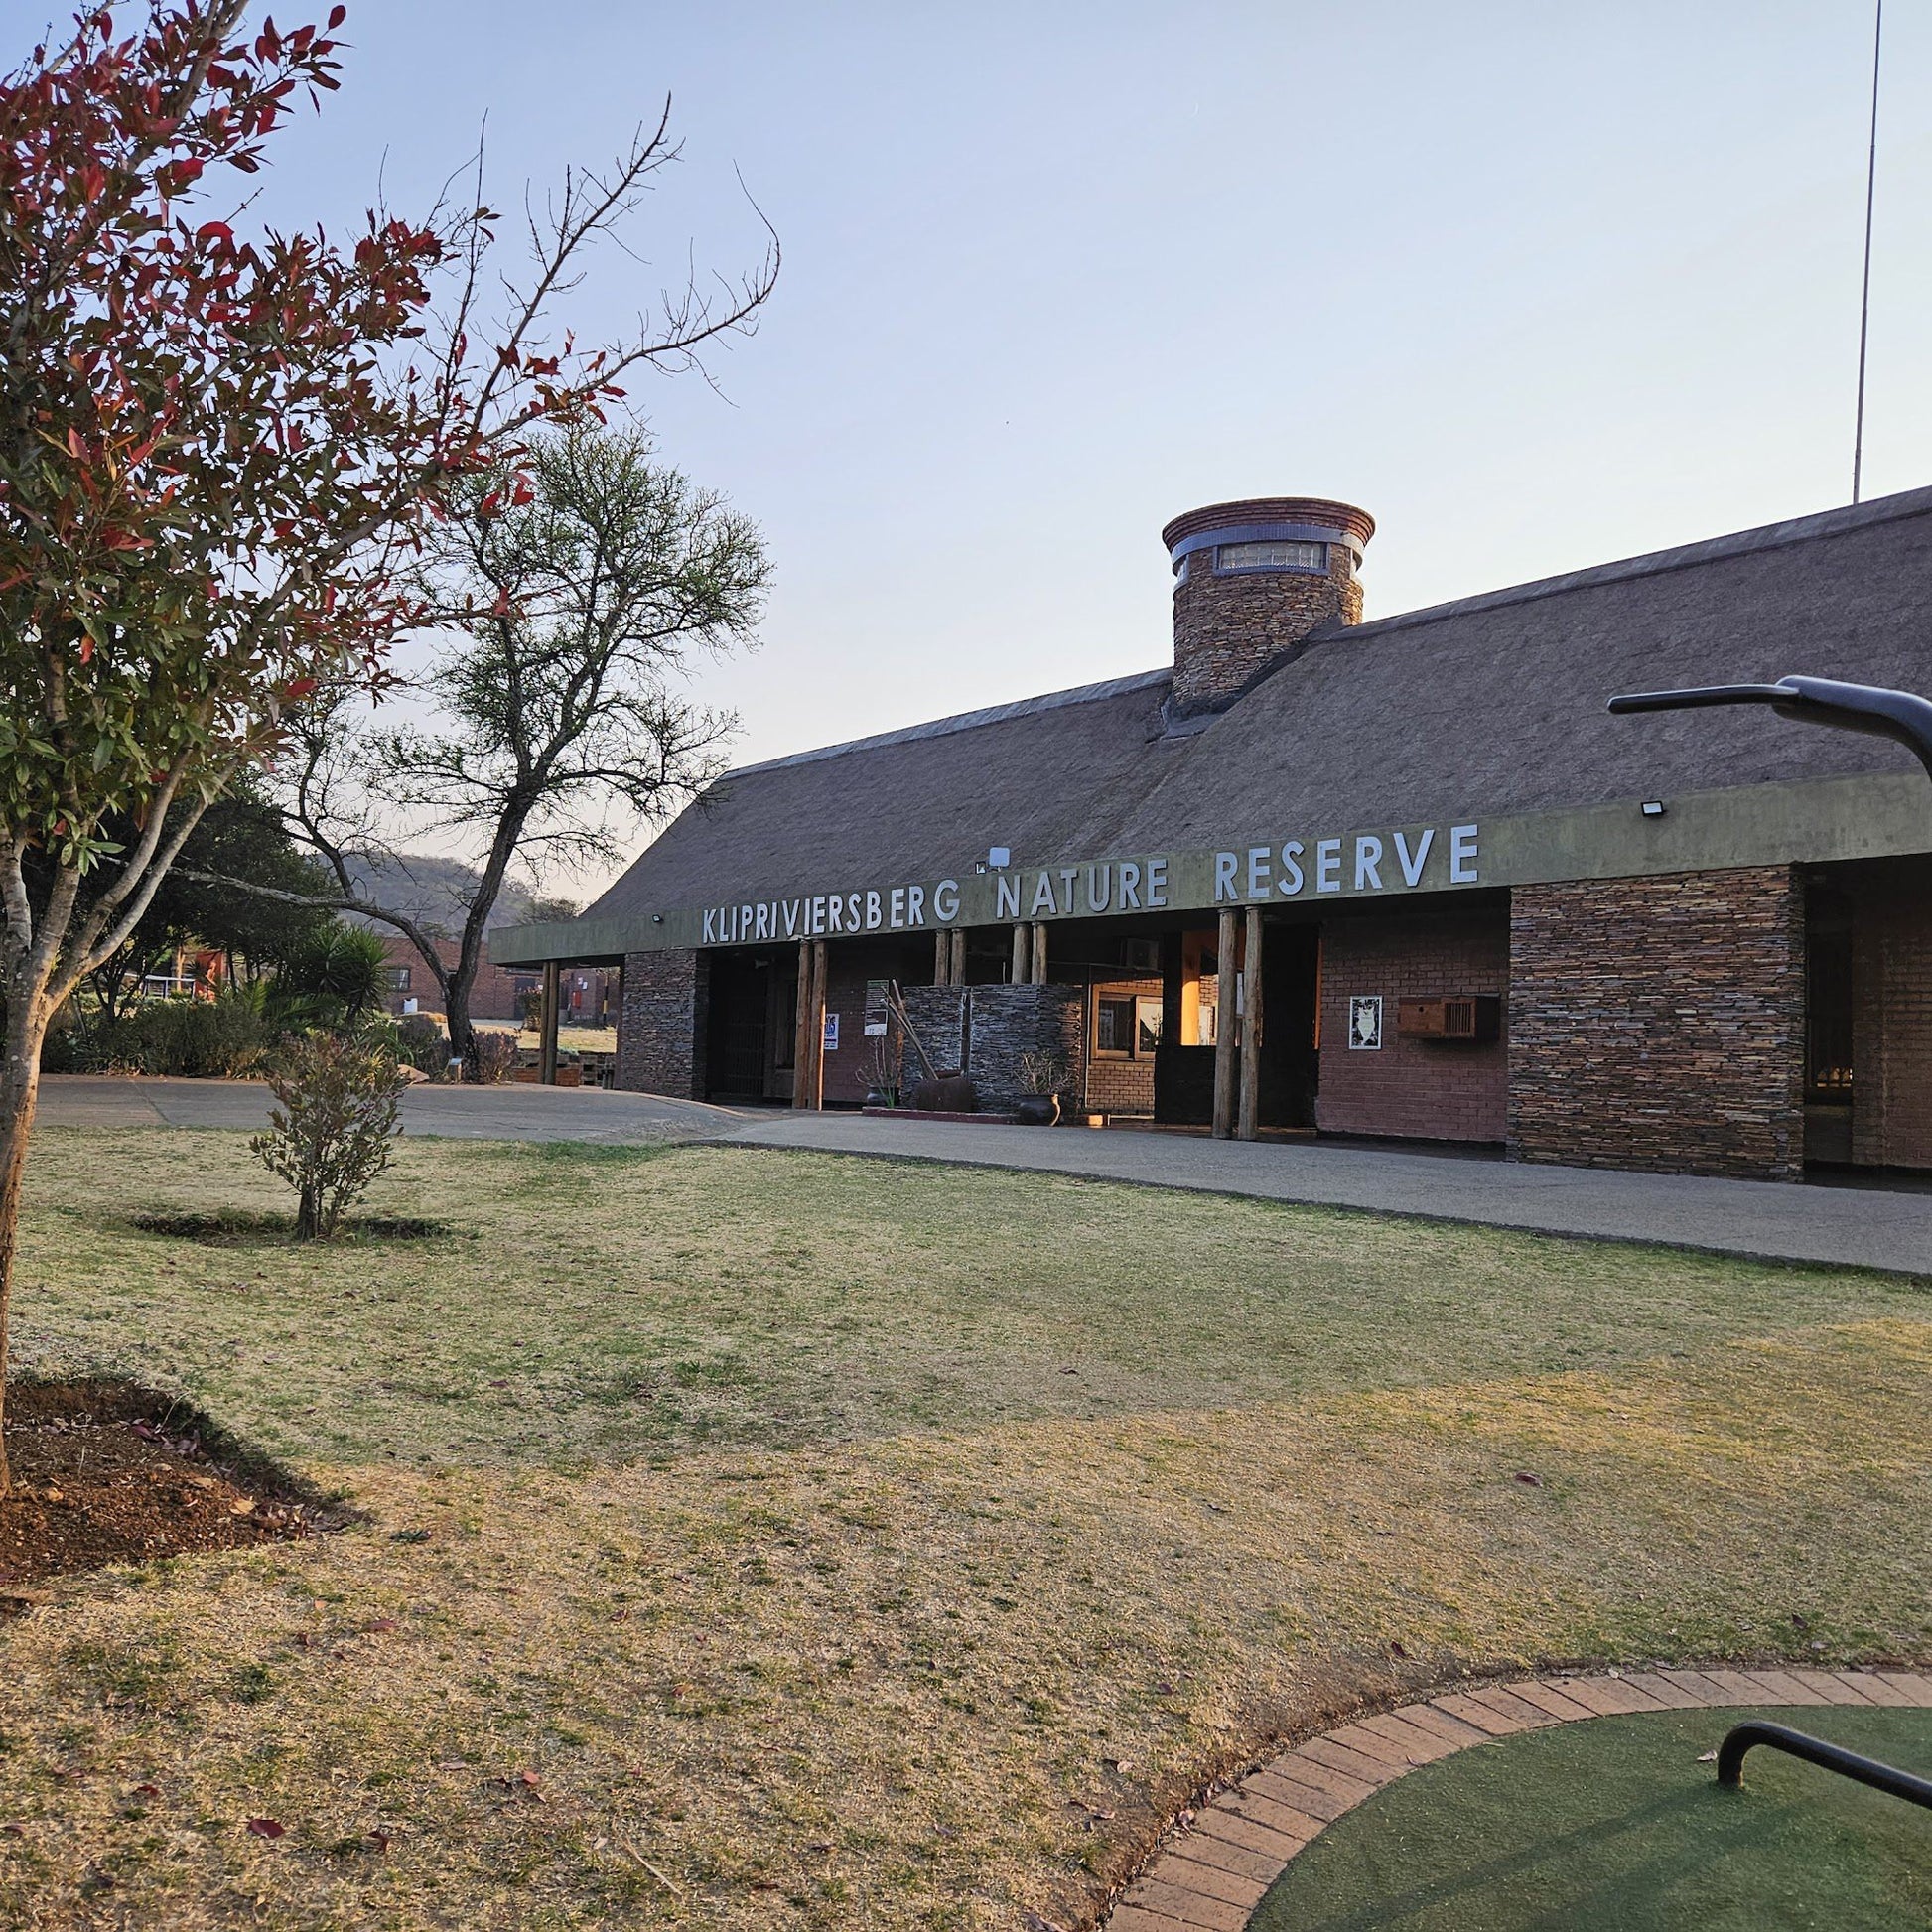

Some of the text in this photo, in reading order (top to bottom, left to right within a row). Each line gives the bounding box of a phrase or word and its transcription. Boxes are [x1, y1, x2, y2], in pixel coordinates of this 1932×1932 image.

[703, 823, 1479, 944] KLIPRIVIERSBERG NATURE RESERVE
